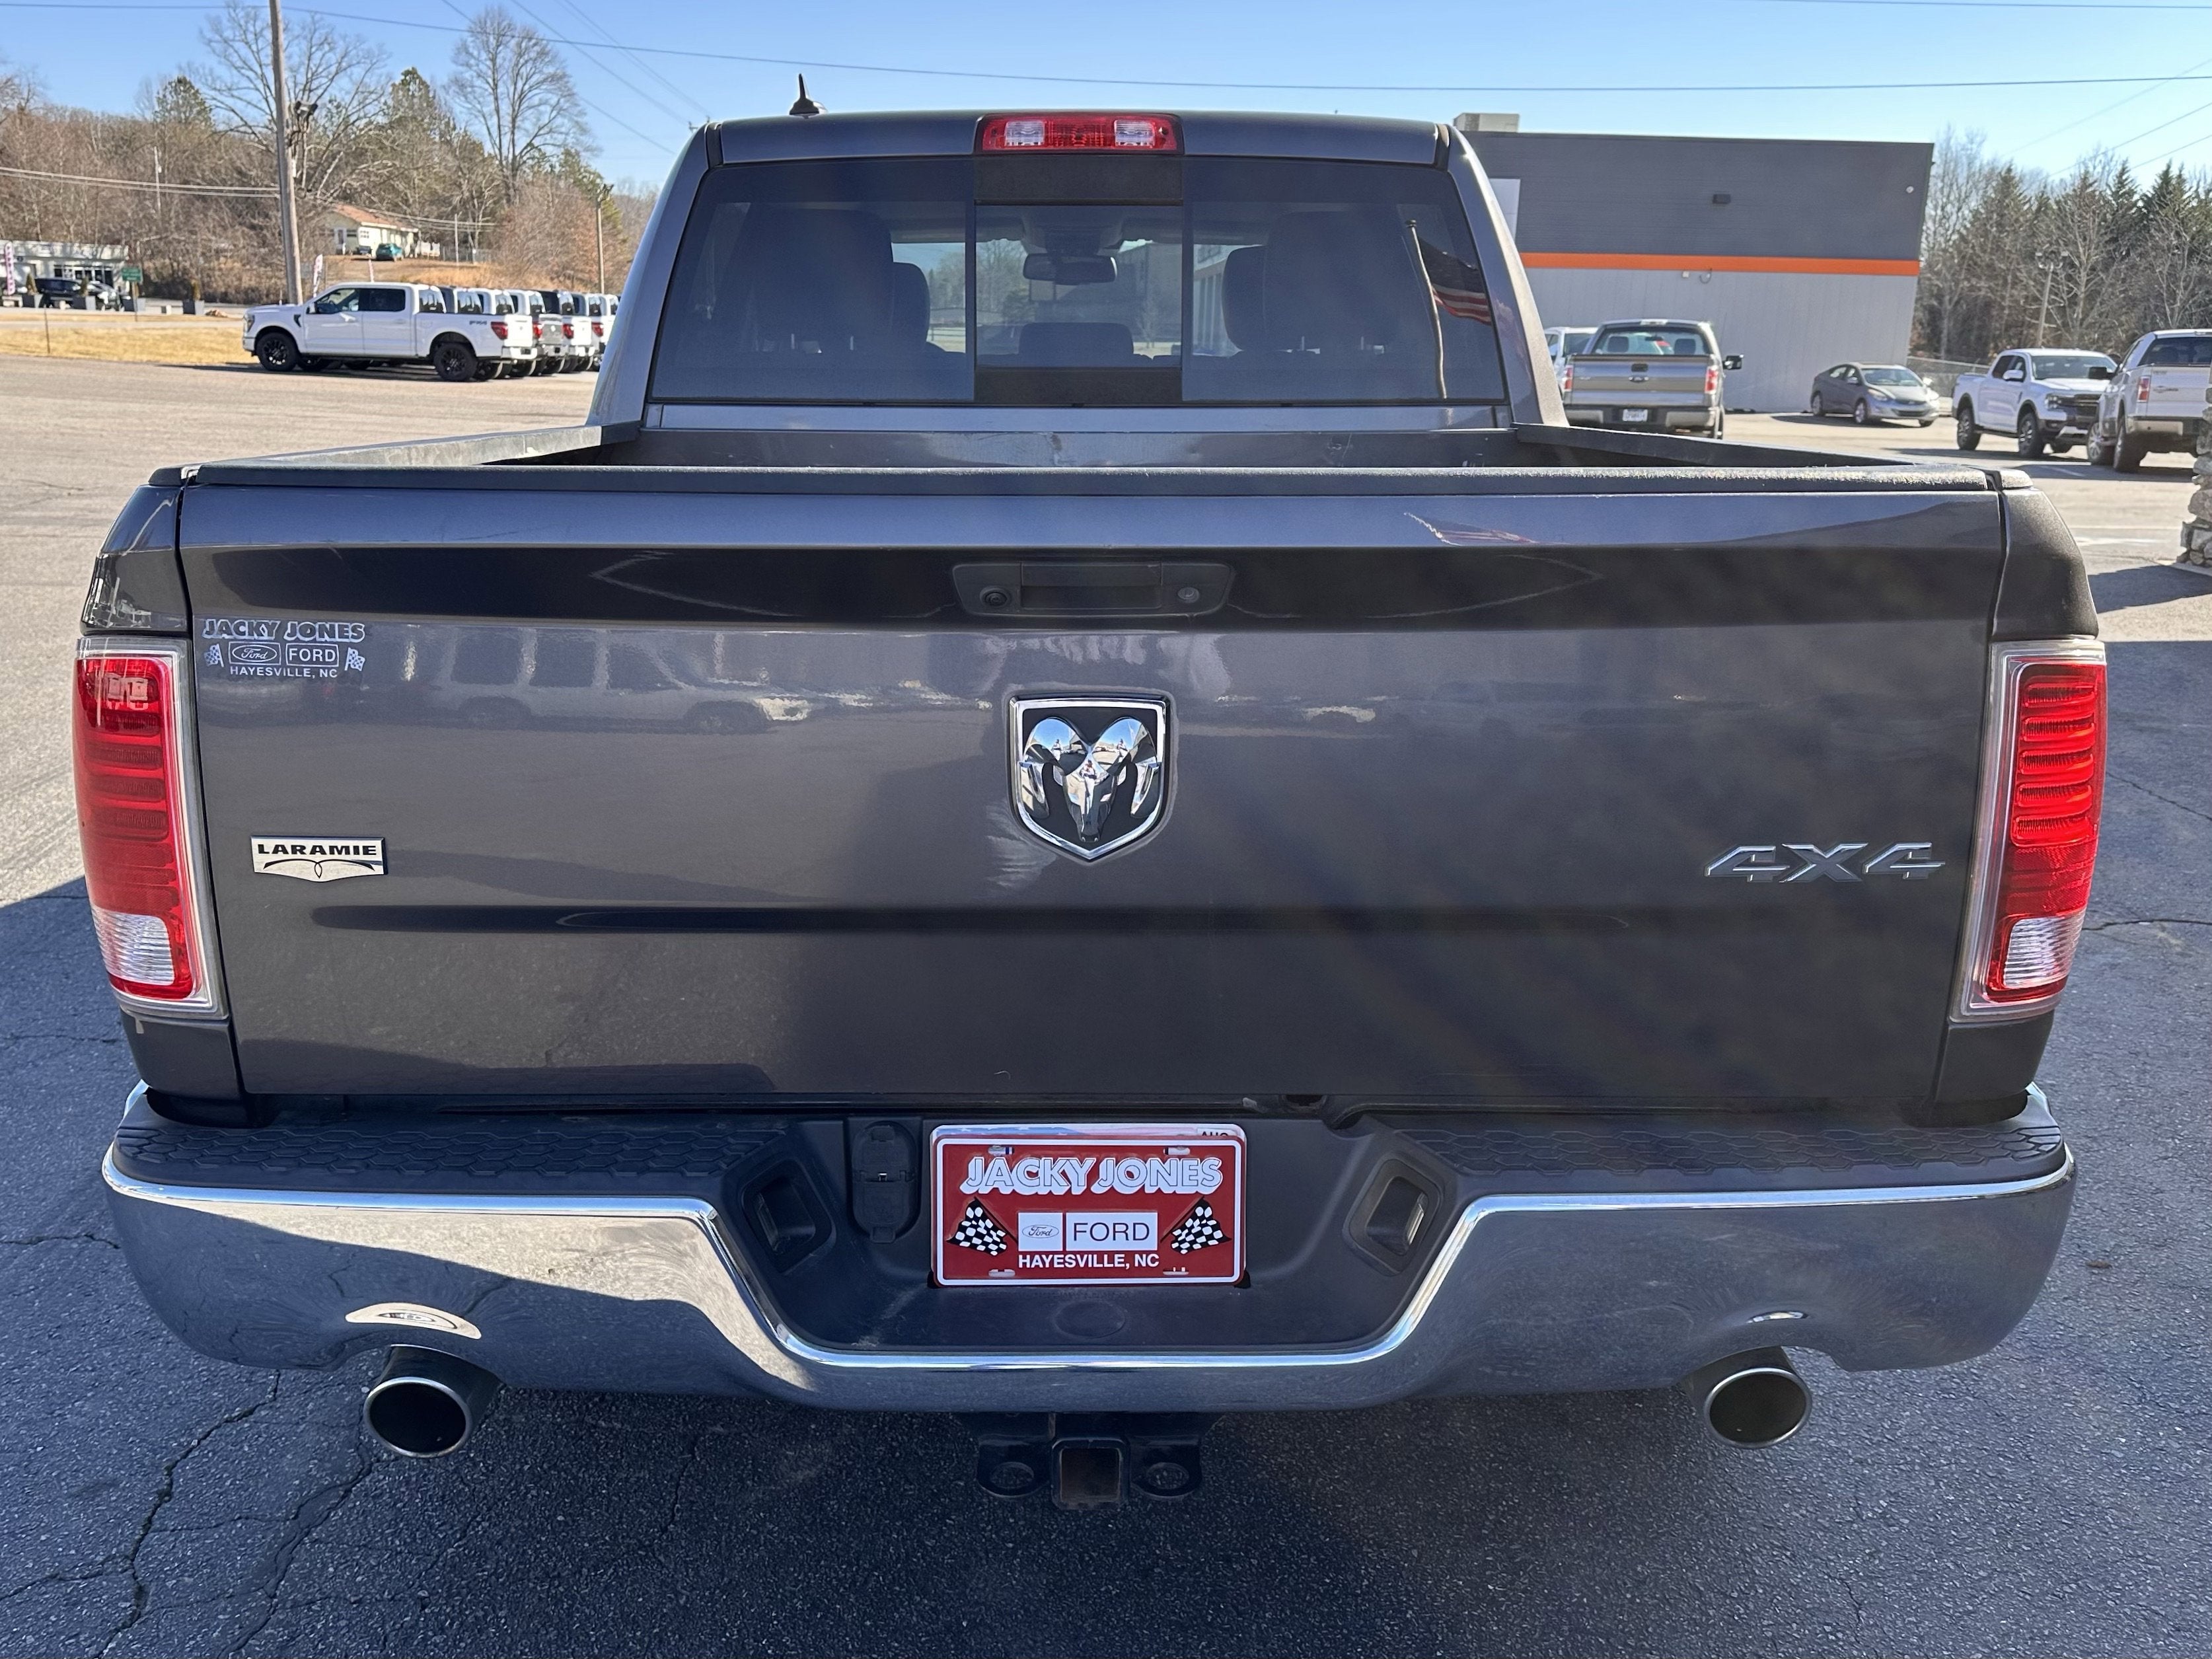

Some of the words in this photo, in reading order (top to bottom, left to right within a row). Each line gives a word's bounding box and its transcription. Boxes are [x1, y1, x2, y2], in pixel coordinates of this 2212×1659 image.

[202, 619, 281, 640] JACKY
[283, 621, 365, 643] JONES
[241, 648, 268, 660] Ford
[289, 648, 336, 662] FORD
[230, 666, 315, 679] HAYESVILLE,
[320, 669, 338, 678] NC
[258, 844, 377, 856] LARAMIE
[1704, 842, 1946, 883] 4X4
[960, 1157, 1097, 1195] JACKY
[1091, 1157, 1223, 1195] JONES
[1028, 1226, 1052, 1236] Ford
[1074, 1222, 1150, 1241] FORD
[1018, 1254, 1130, 1270] HAYESVILLE,
[1134, 1253, 1160, 1267] NC
